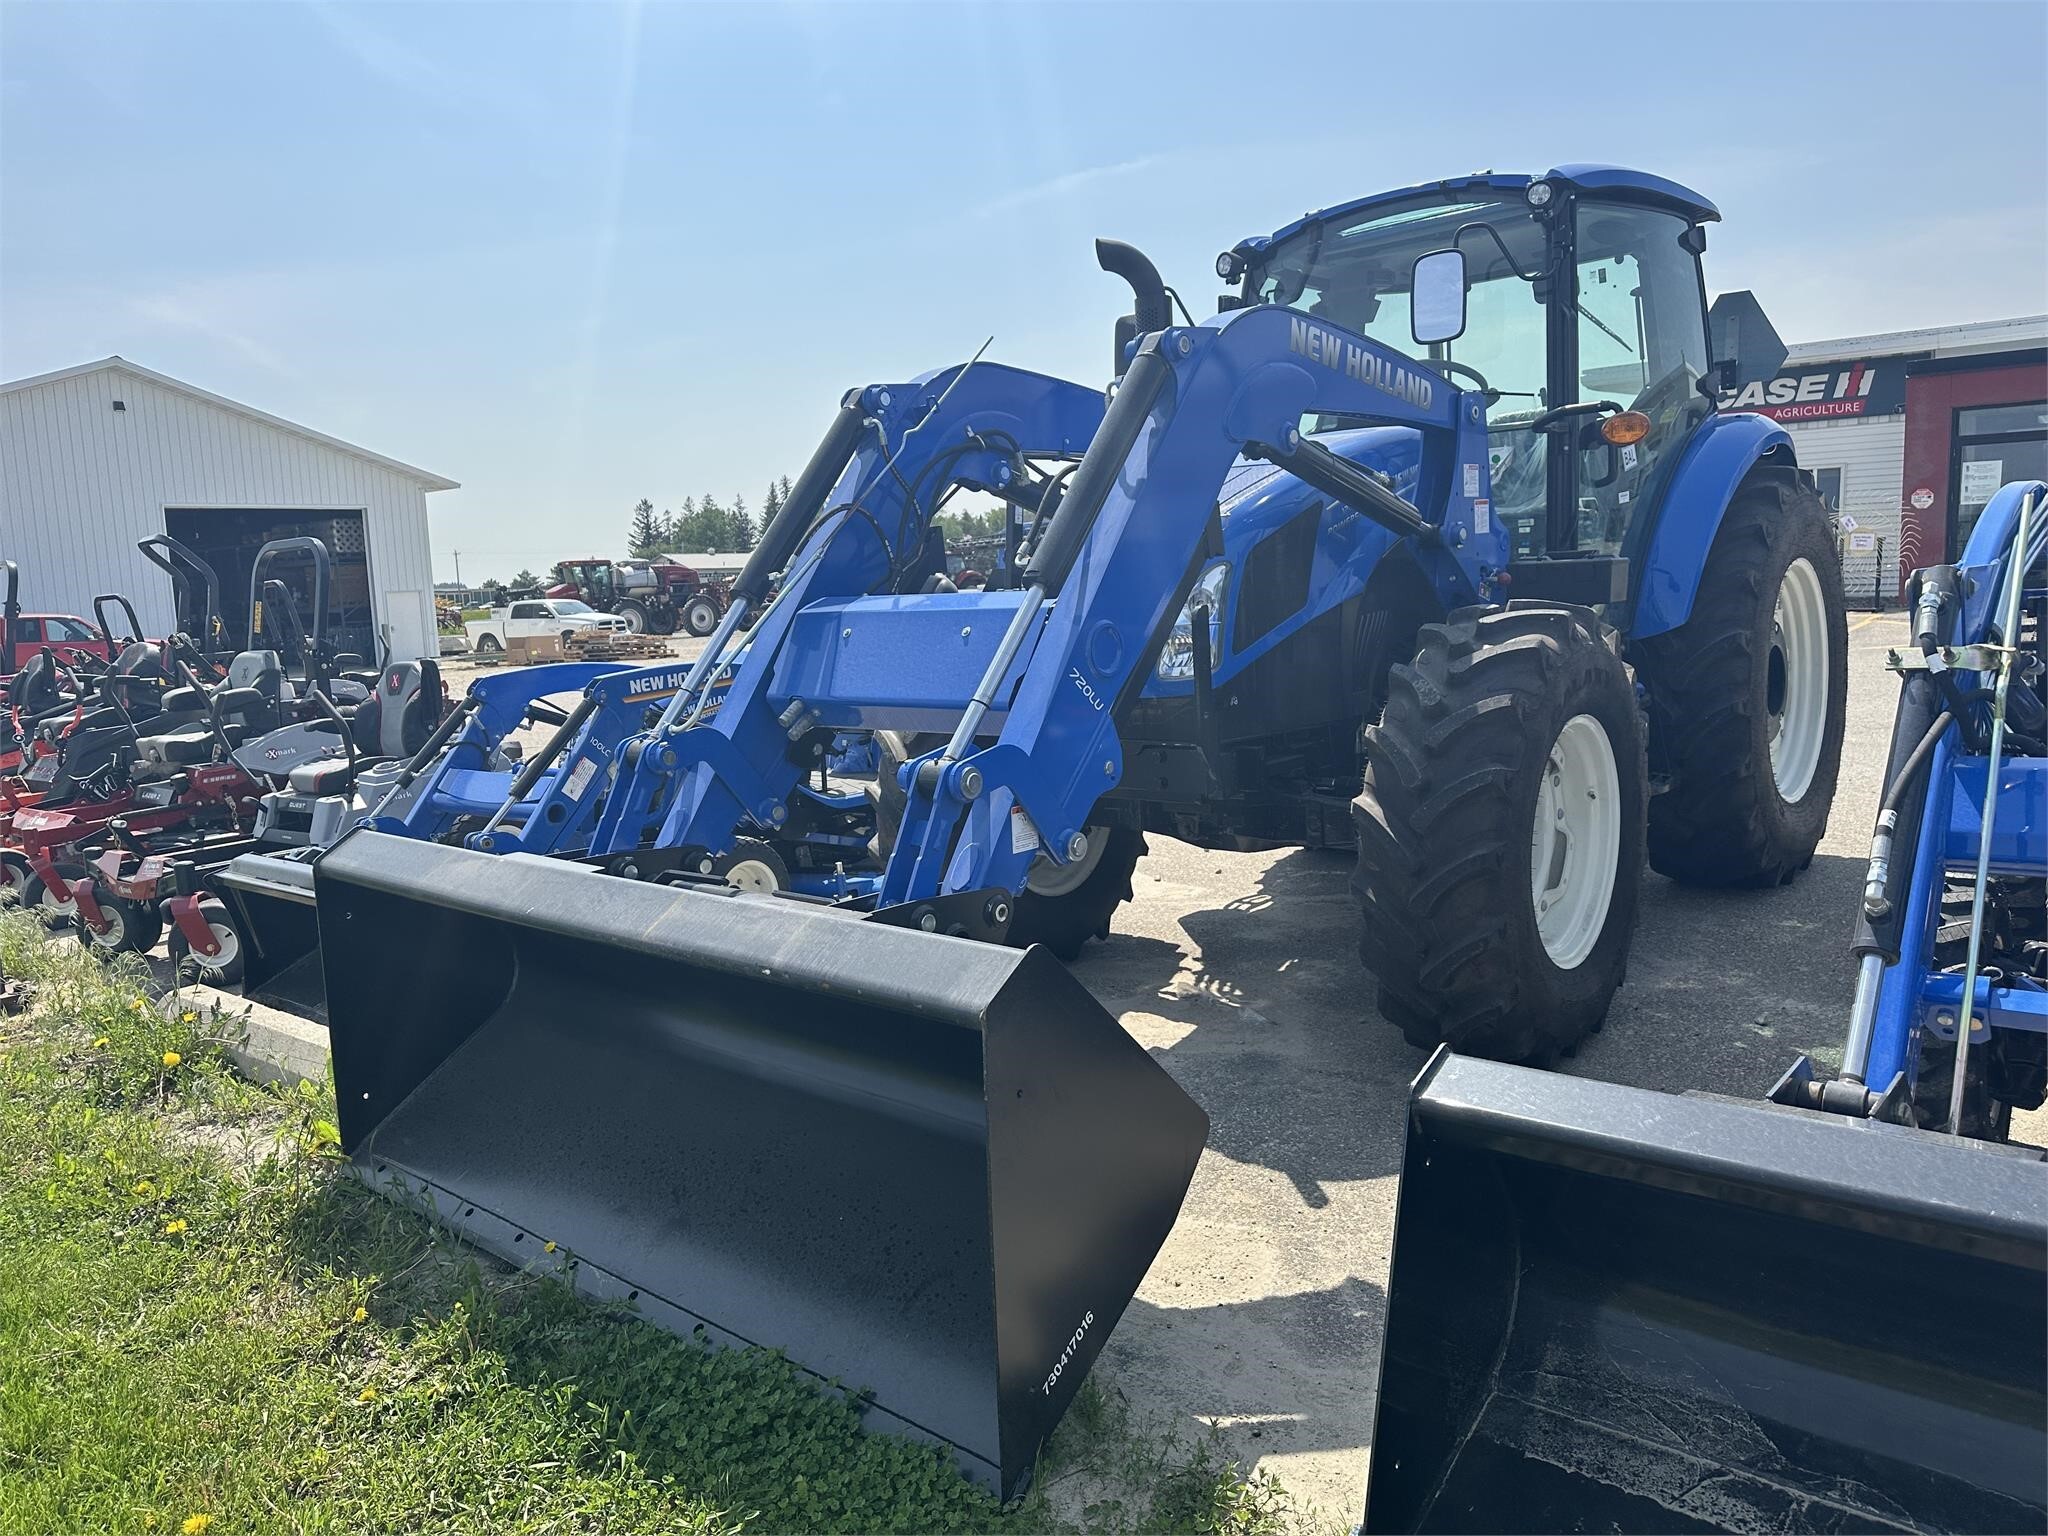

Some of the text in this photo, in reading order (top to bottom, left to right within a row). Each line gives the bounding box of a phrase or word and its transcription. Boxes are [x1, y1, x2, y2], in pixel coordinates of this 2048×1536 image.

[1290, 317, 1433, 411] NEW HOLLAND
[1774, 401, 1861, 419] AGRICULTURE
[1623, 448, 1636, 466] BAL
[629, 675, 665, 695] NEW
[1069, 667, 1104, 710] 720LU
[590, 736, 611, 757] 100LC
[1042, 1310, 1094, 1396] 730417016
